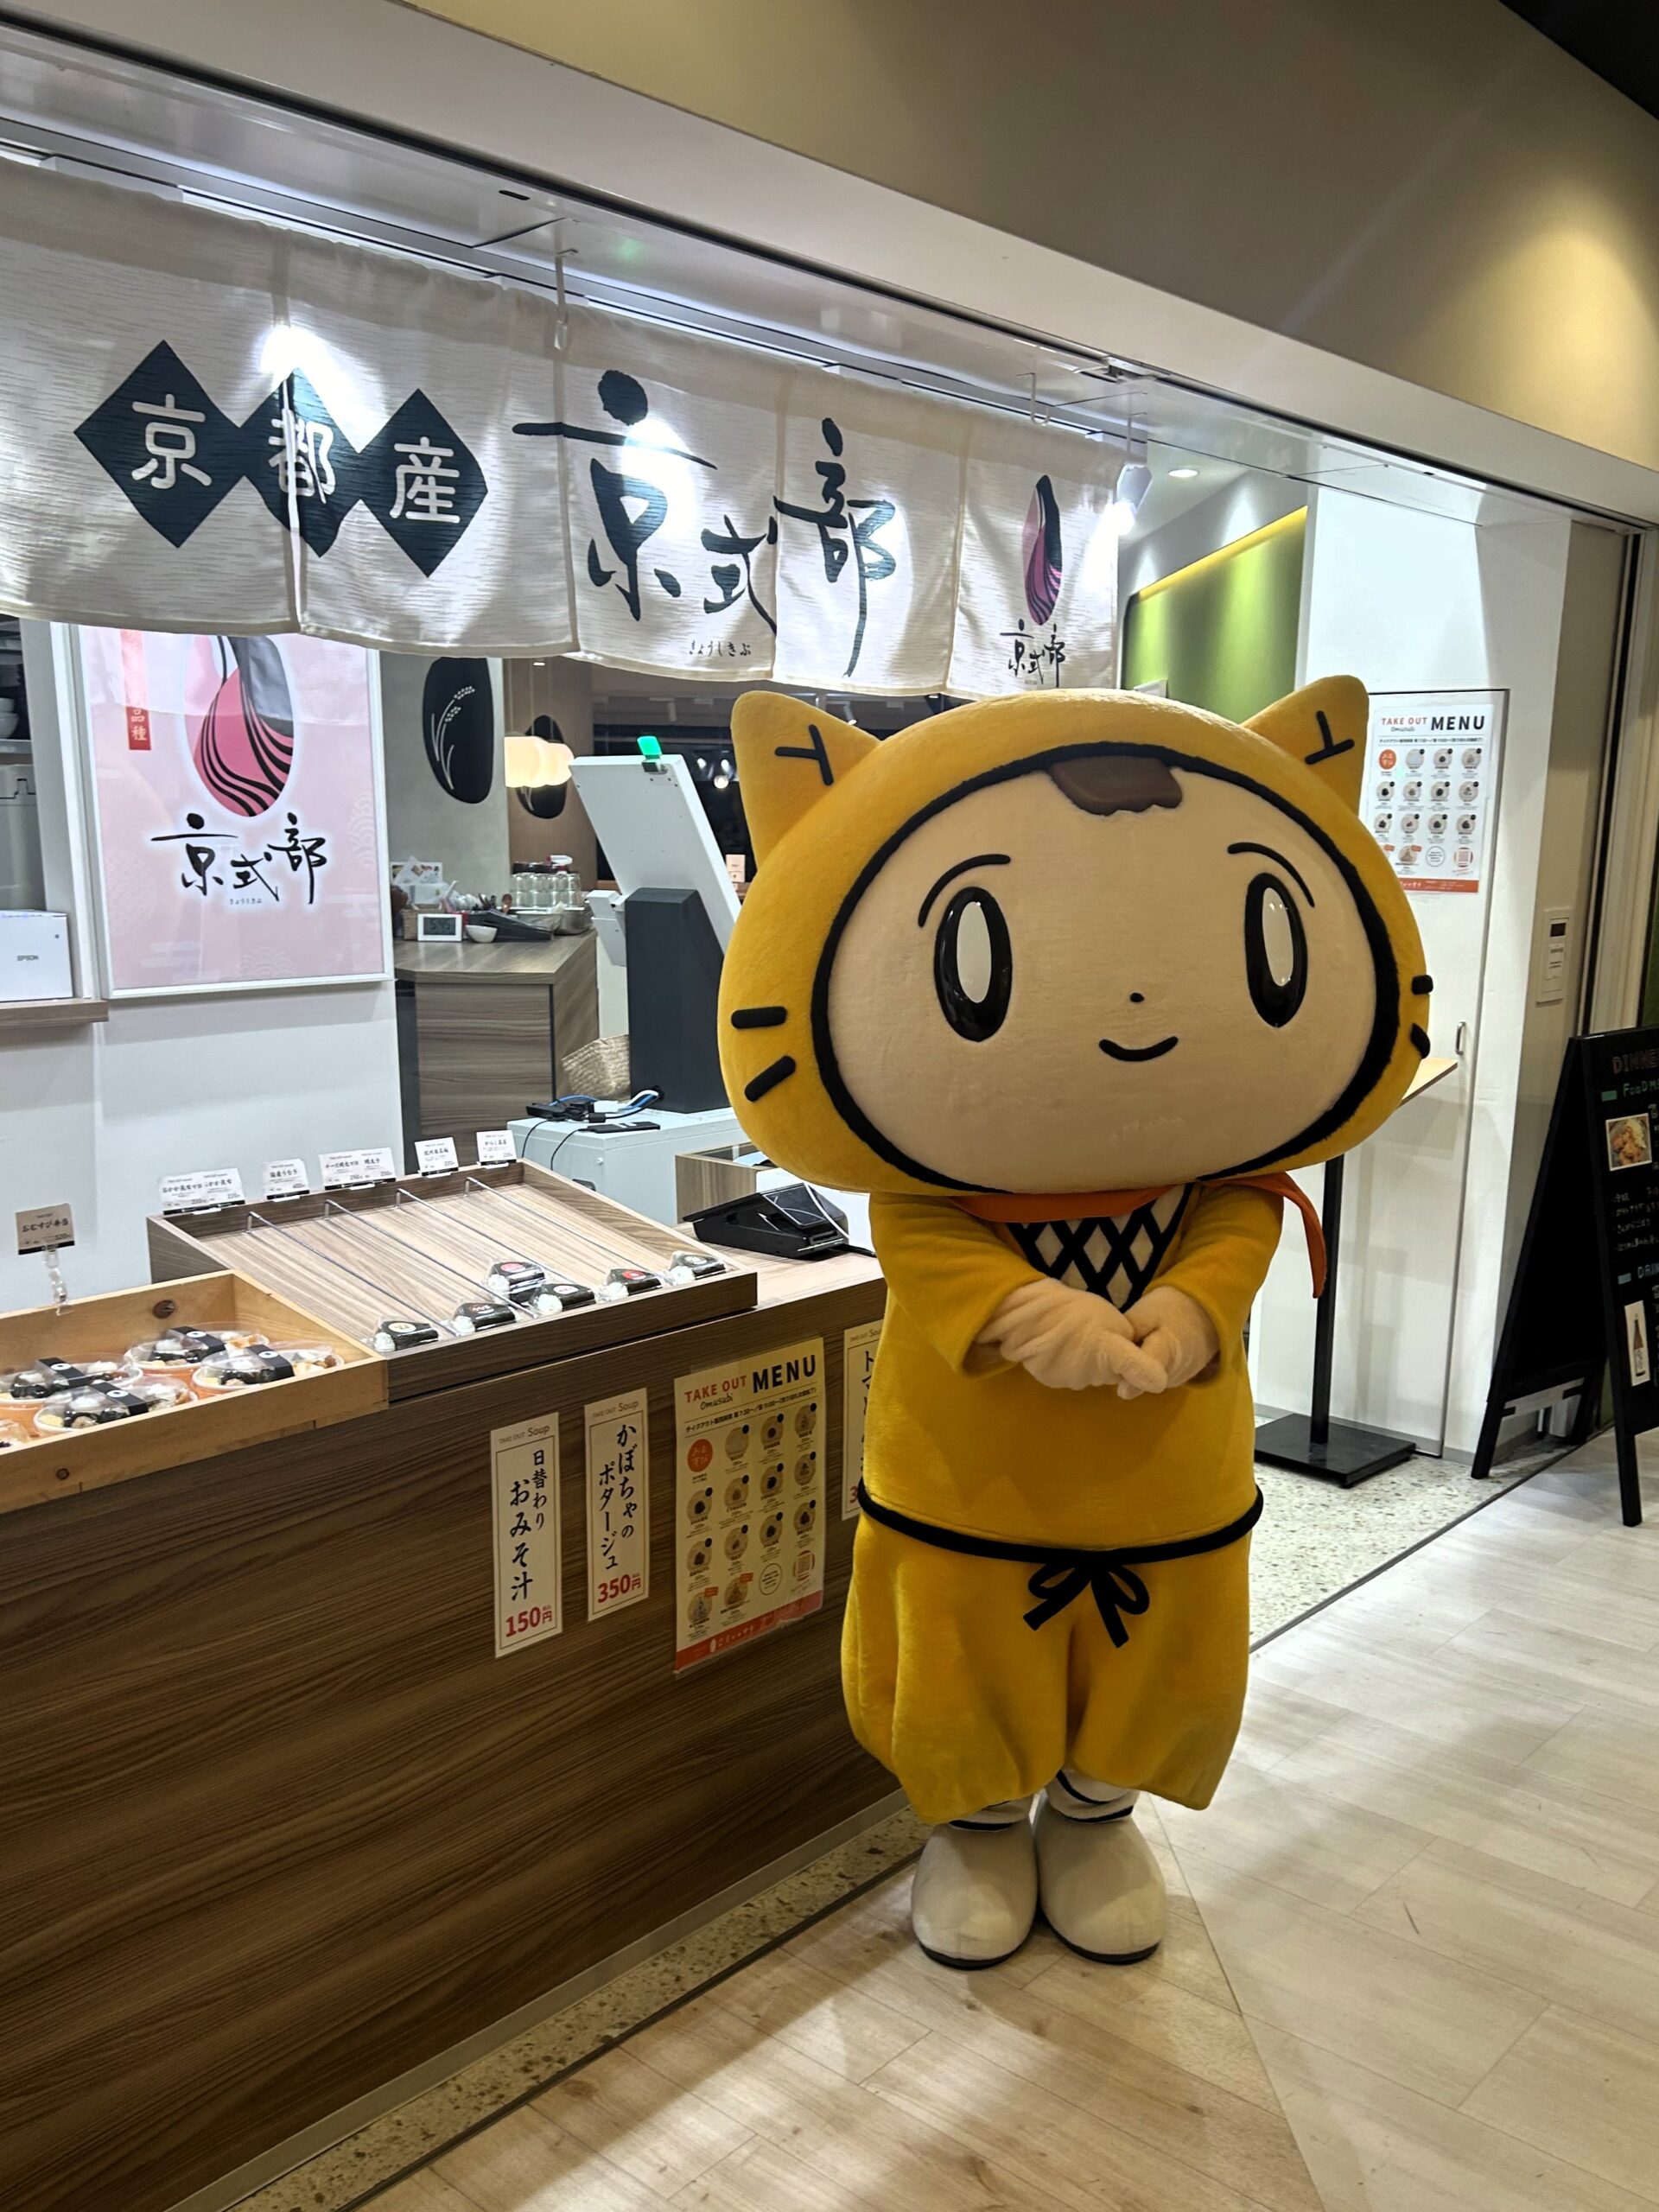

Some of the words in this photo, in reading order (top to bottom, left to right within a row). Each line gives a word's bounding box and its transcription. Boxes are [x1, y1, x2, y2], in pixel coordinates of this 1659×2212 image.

[131, 393, 461, 524] 京都産
[690, 639, 751, 657] きょうしきぶ
[1408, 716, 1427, 725] OUT
[1431, 715, 1485, 731] MENU
[618, 1400, 639, 1413] Soup
[684, 1384, 718, 1403] TAKE
[721, 1376, 747, 1392] OUT
[753, 1355, 816, 1393] MENU
[528, 1425, 550, 1438] Soup
[531, 1449, 548, 1530] 日替わり
[616, 1424, 639, 1538] かぼちゃの
[510, 1478, 533, 1601] おみそ汁
[599, 1460, 619, 1570] ポタージュ
